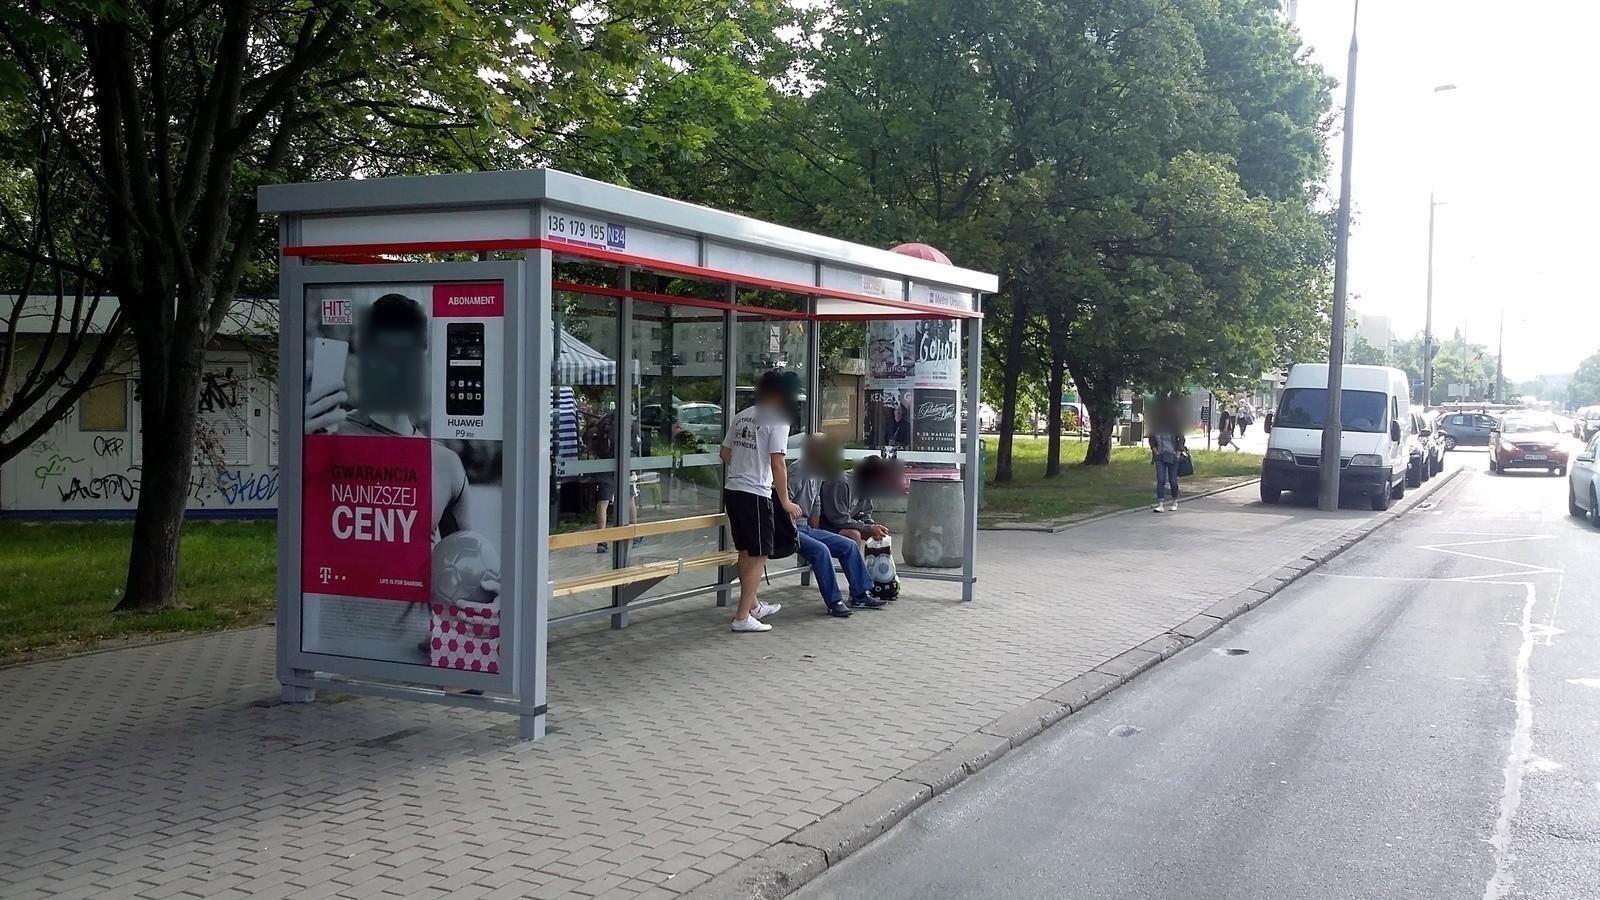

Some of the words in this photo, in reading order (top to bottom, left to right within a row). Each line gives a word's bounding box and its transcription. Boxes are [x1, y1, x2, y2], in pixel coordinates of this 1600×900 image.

[548, 215, 565, 233] 136
[569, 220, 586, 237] 179
[590, 224, 605, 241] 195
[607, 226, 625, 245] N34
[323, 300, 344, 316] HIT
[448, 296, 495, 306] ABONAMENT
[447, 419, 484, 428] HUAWEI
[455, 429, 466, 438] P9
[331, 464, 417, 482] GWARANCJA
[331, 482, 417, 507] NAJNIŻSZEJ
[331, 505, 418, 543] CENY
